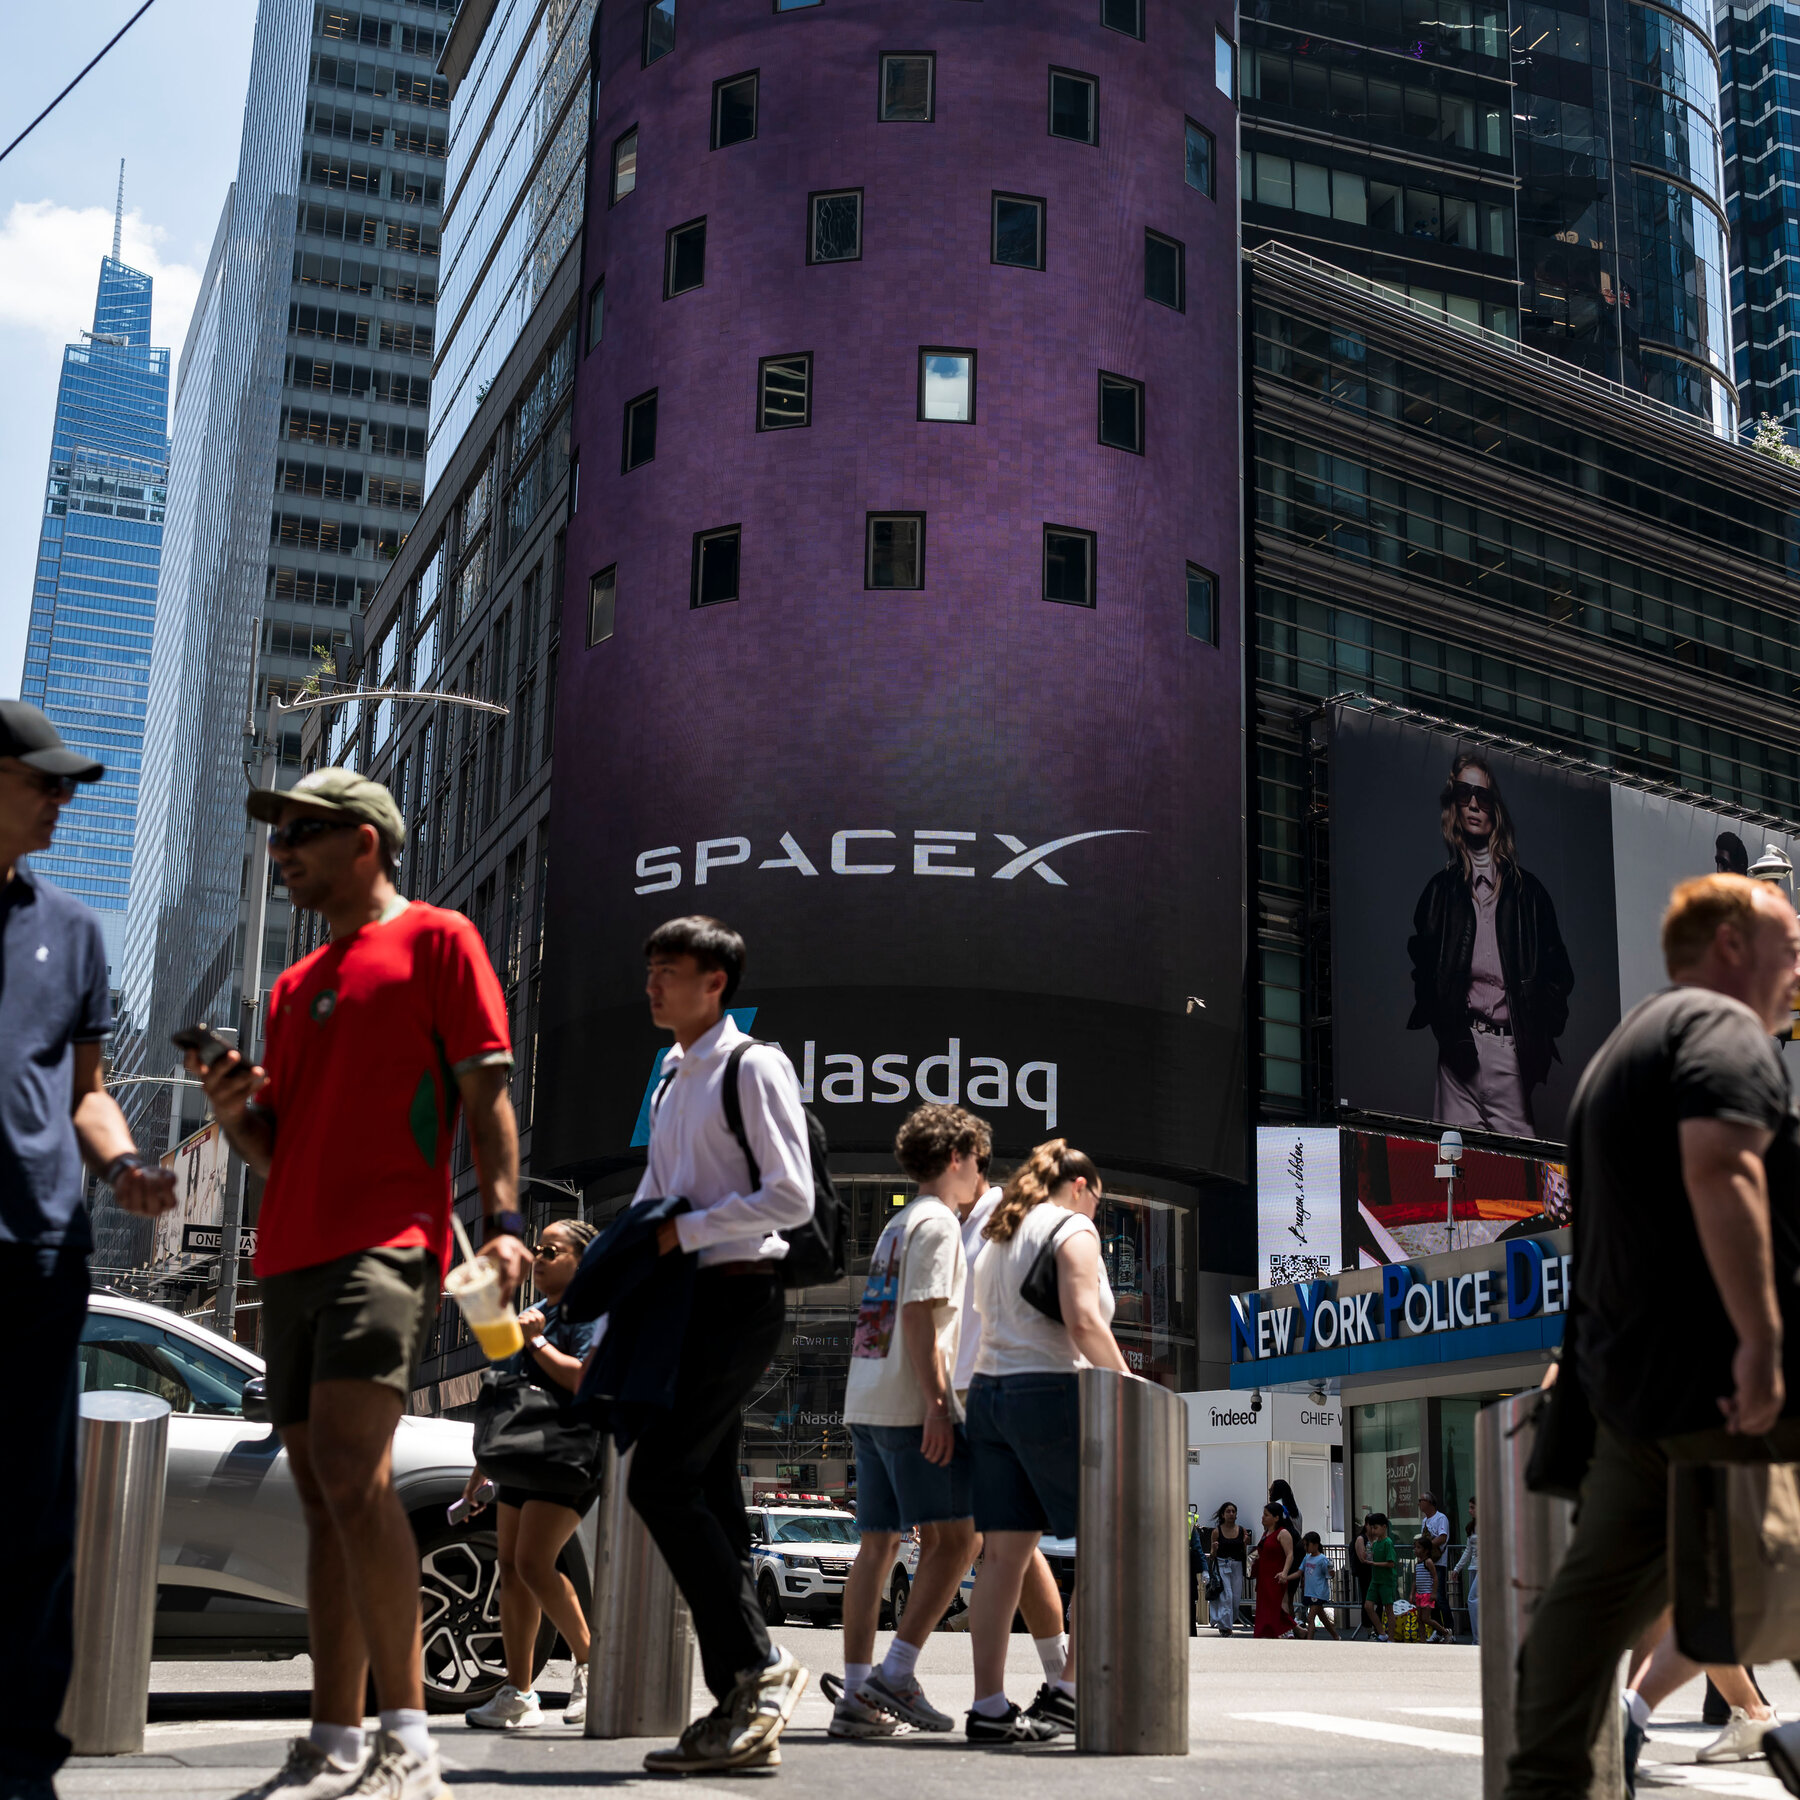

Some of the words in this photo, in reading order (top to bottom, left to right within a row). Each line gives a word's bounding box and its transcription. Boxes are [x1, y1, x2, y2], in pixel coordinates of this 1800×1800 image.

[634, 829, 1151, 896] SPACEX
[195, 1233, 222, 1247] ONE
[1229, 1293, 1294, 1363] NEW
[1294, 1279, 1376, 1352] YORK
[1382, 1264, 1493, 1338] POLICE
[792, 1337, 839, 1346] REWRITE
[1208, 1406, 1257, 1427] indeed
[1300, 1410, 1334, 1426] CHIEF
